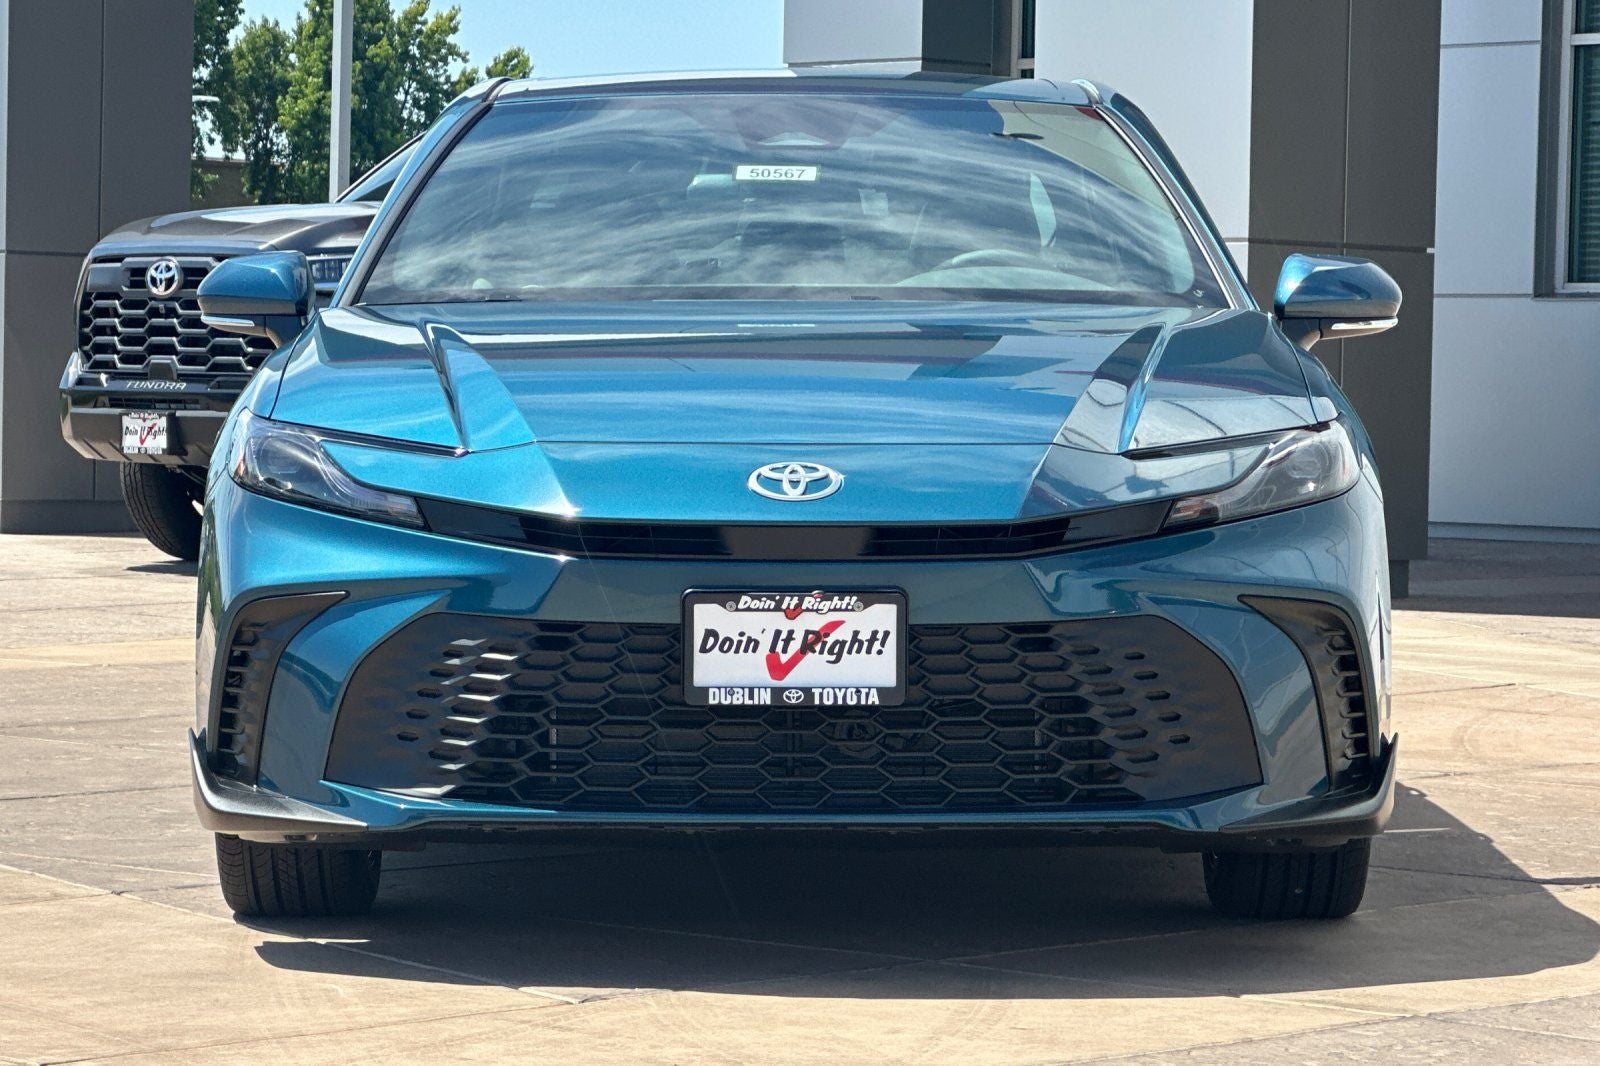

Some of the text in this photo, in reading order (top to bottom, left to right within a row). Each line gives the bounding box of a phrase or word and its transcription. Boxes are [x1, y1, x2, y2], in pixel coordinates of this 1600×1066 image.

[749, 168, 806, 179] 50567
[124, 380, 187, 390] TUNDRA
[781, 596, 798, 610] It
[801, 596, 858, 614] Right!
[699, 628, 891, 664] Doin' It Right!
[708, 688, 880, 705] DUBLIN TOYOTA
